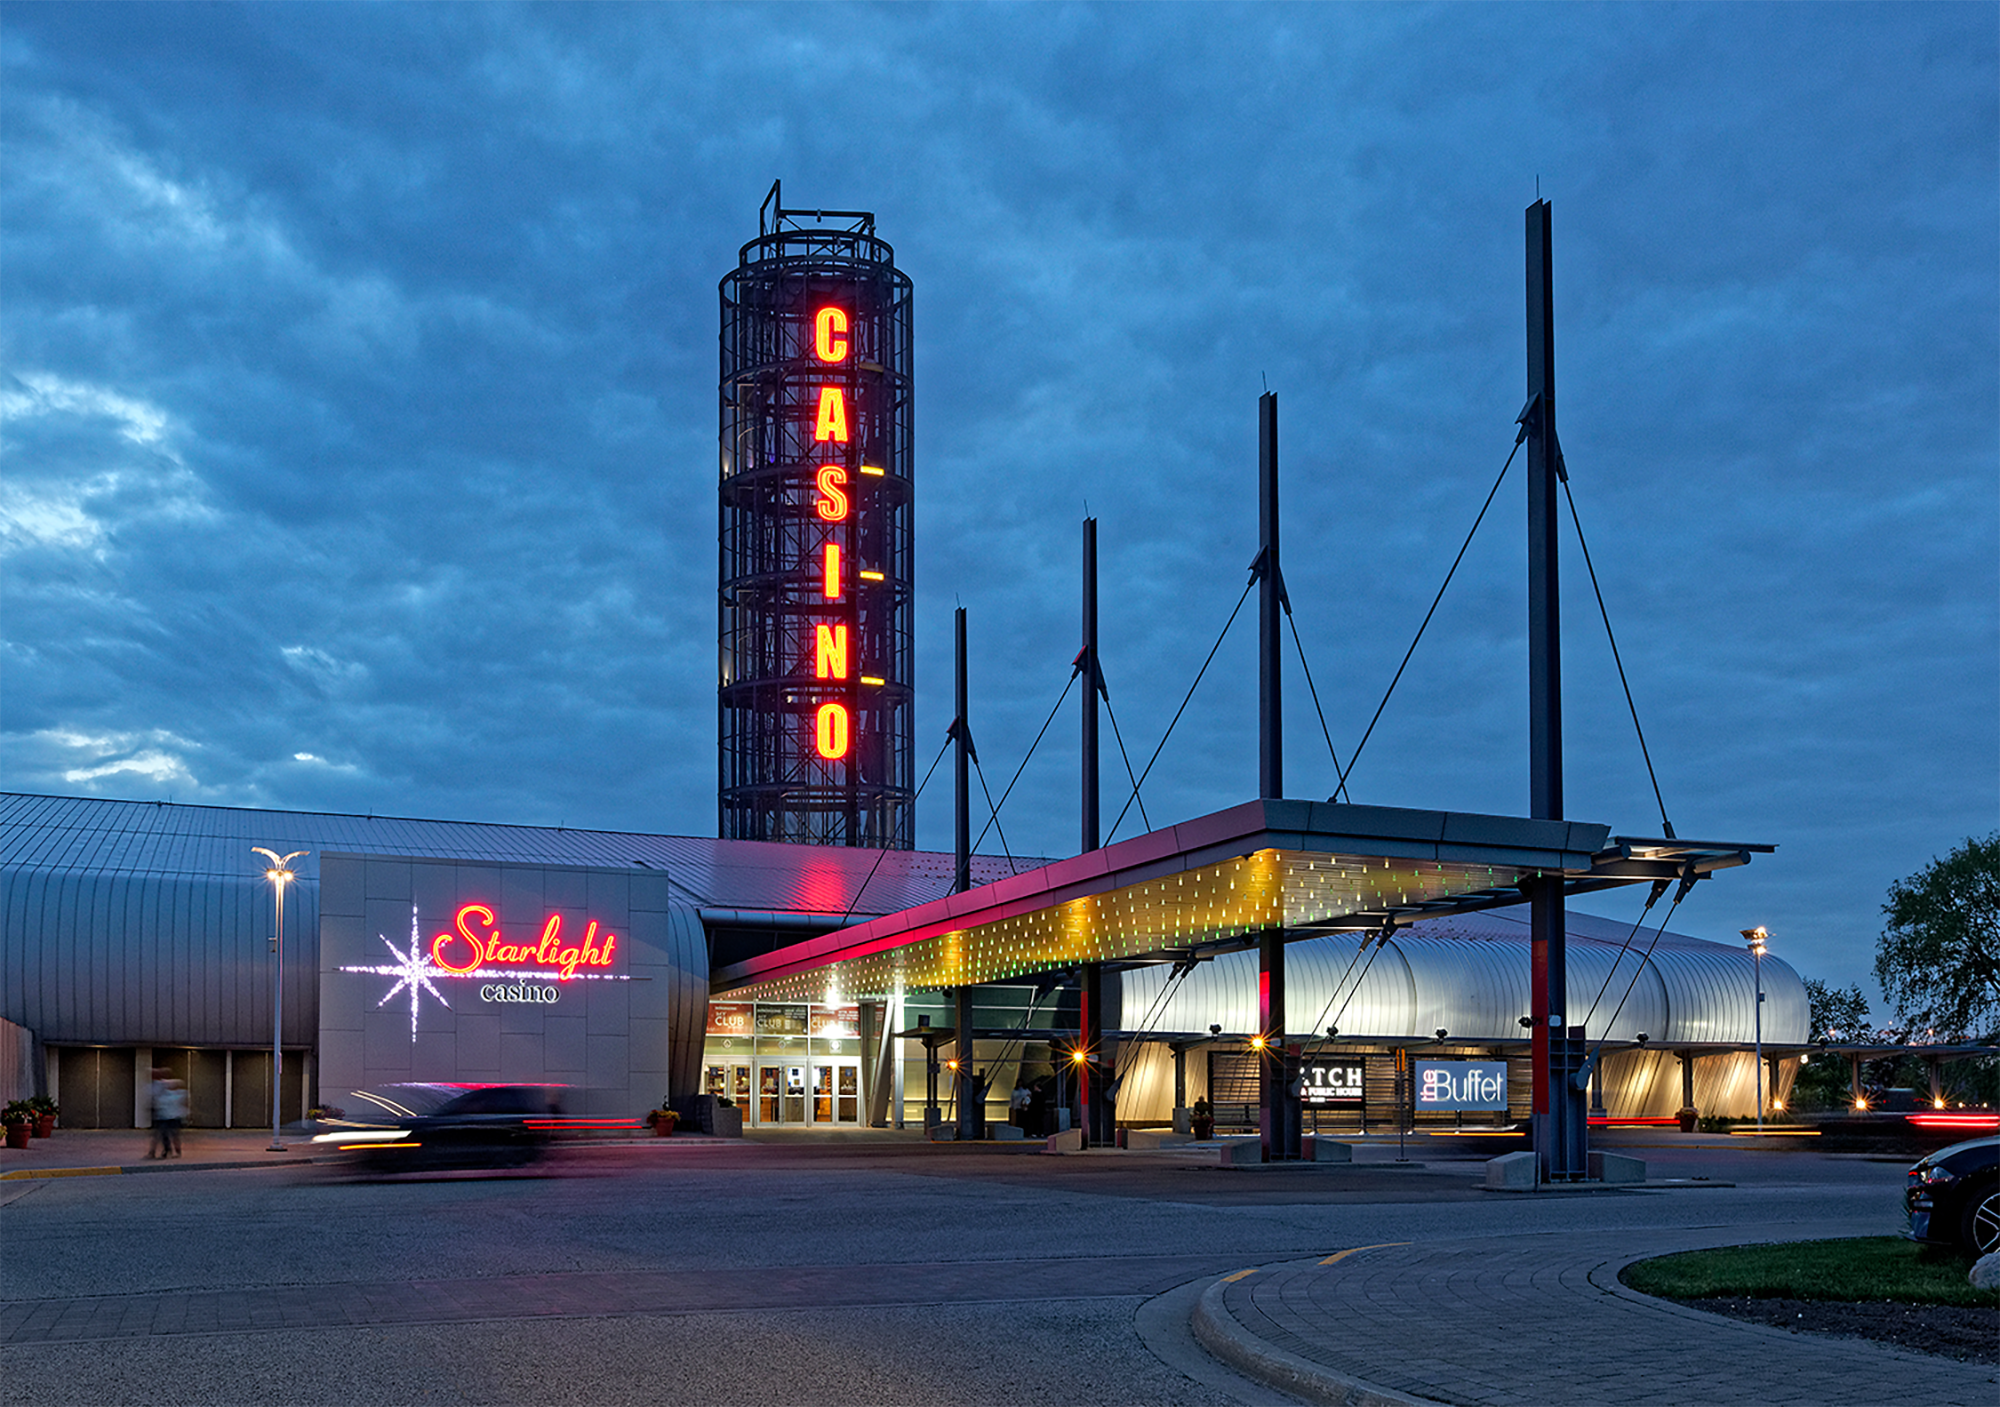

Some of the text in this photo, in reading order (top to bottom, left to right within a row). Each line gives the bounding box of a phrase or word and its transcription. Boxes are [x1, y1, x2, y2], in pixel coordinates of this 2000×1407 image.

[815, 307, 849, 759] CASINO
[433, 904, 616, 981] Starlight
[480, 979, 560, 1003] casino
[715, 1016, 744, 1026] CLUB
[757, 1018, 782, 1028] CLUB
[1420, 1069, 1503, 1102] the Buffet
